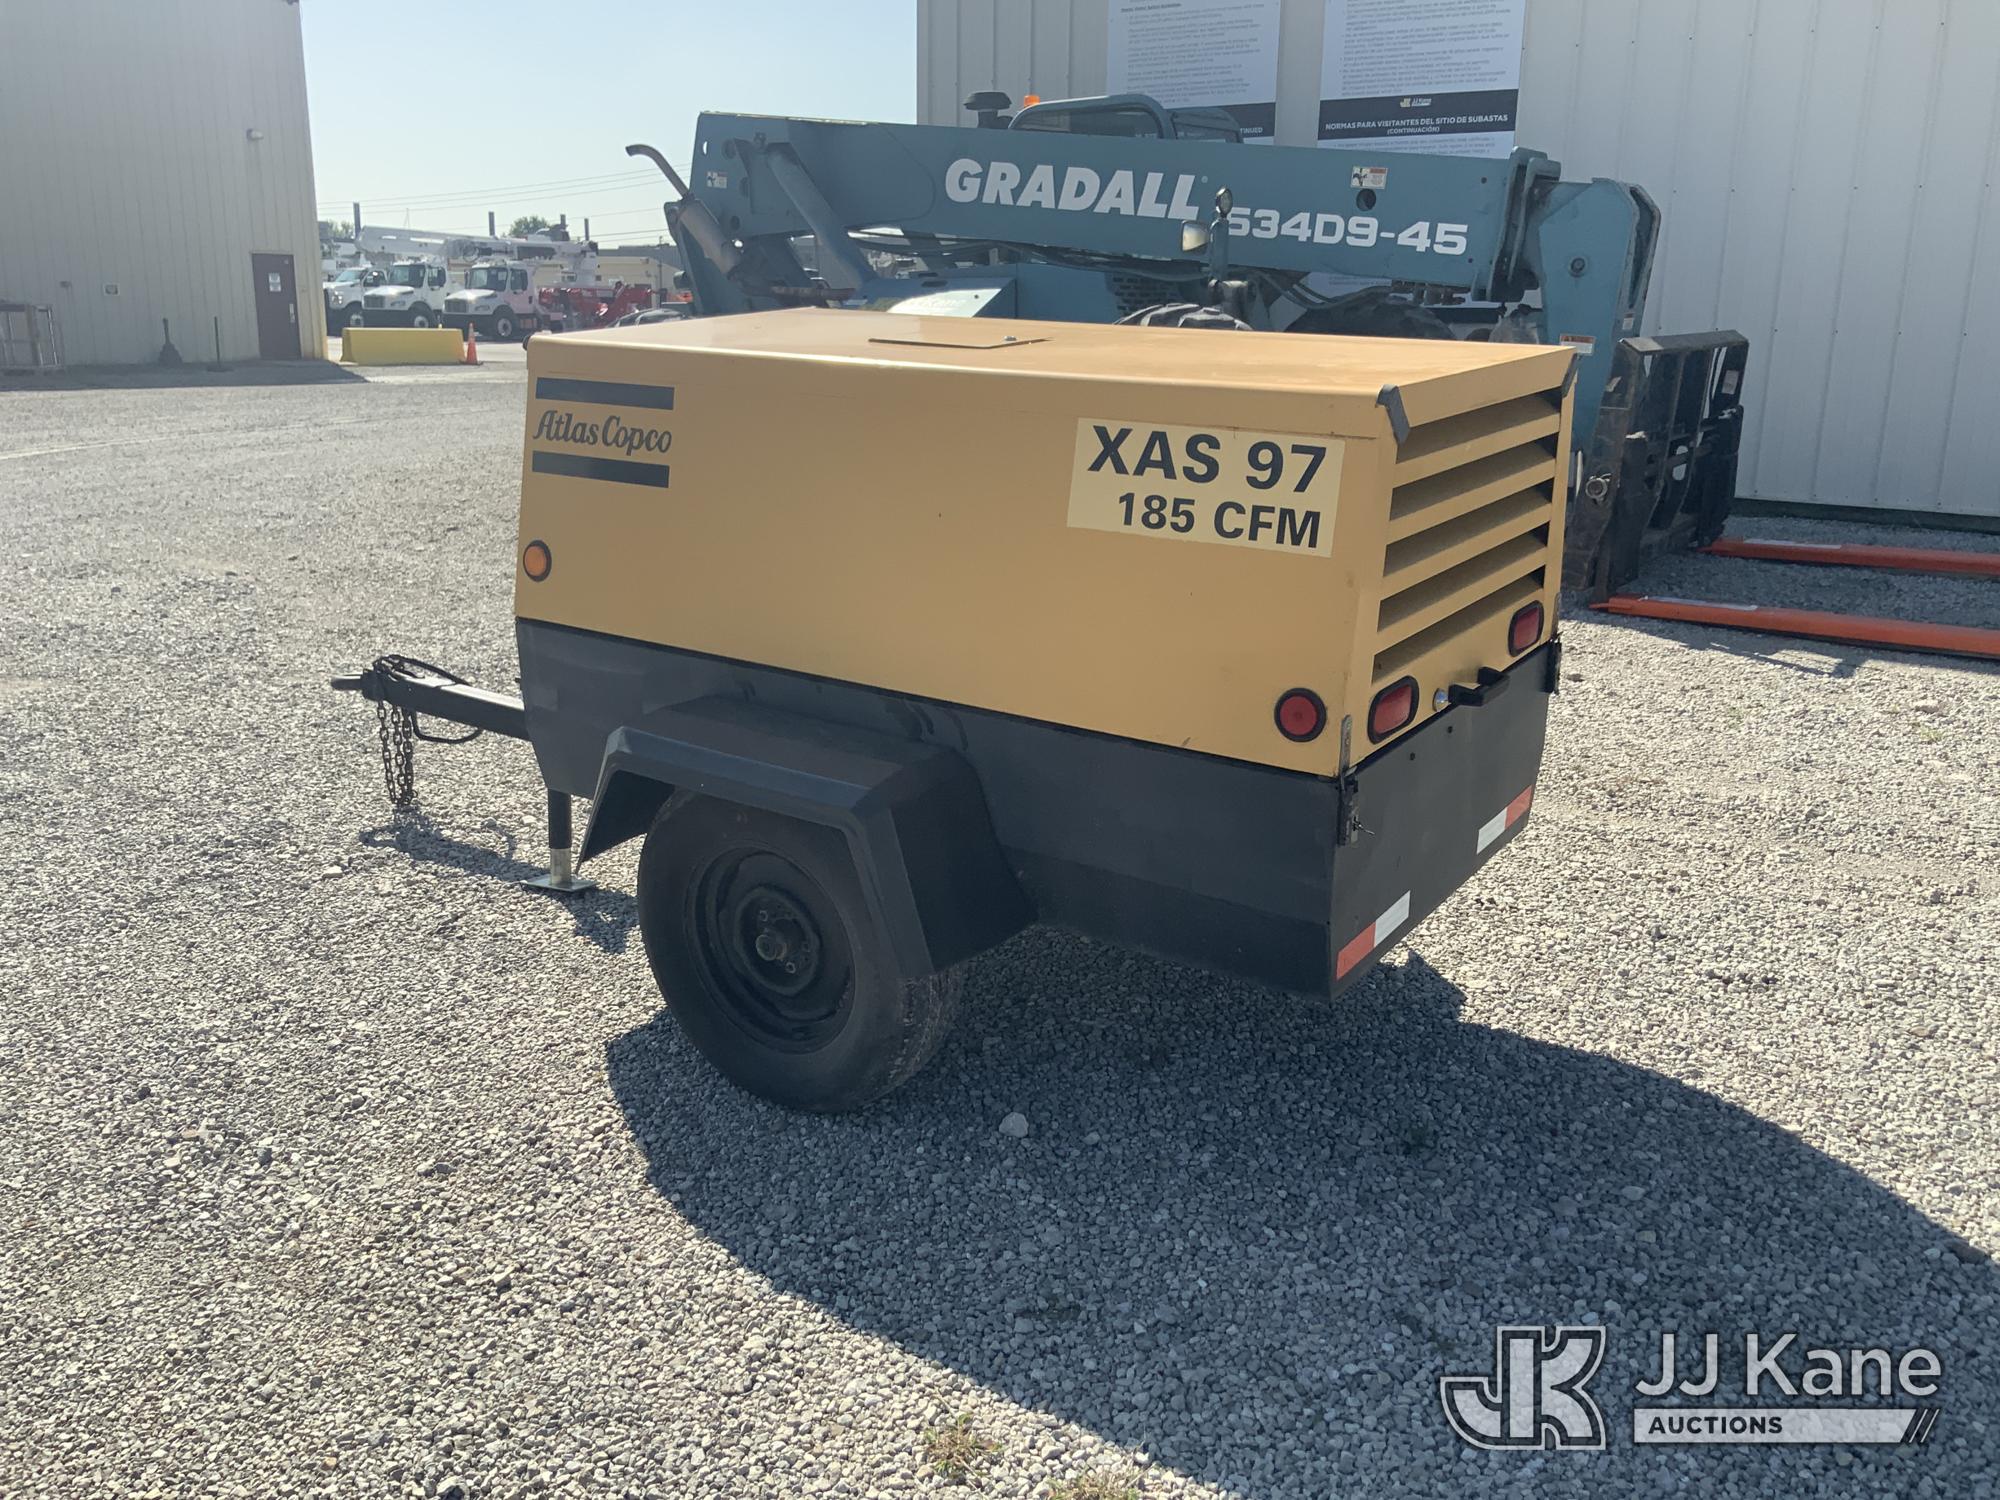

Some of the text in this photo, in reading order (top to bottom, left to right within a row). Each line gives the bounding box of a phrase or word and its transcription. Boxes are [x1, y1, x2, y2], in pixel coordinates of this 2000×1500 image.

[1325, 114, 1508, 130] NORMAS PARA VISITANTES DEL SITIO DE SUBASTAS
[1387, 126, 1440, 135] (CONTINUACIÓN)
[945, 158, 1200, 221] GRADALL
[1226, 206, 1469, 256] 534D9-45
[533, 410, 672, 456] Atlas Copco
[1088, 425, 1327, 493] XAS 97
[1119, 492, 1321, 549] 185 CFM
